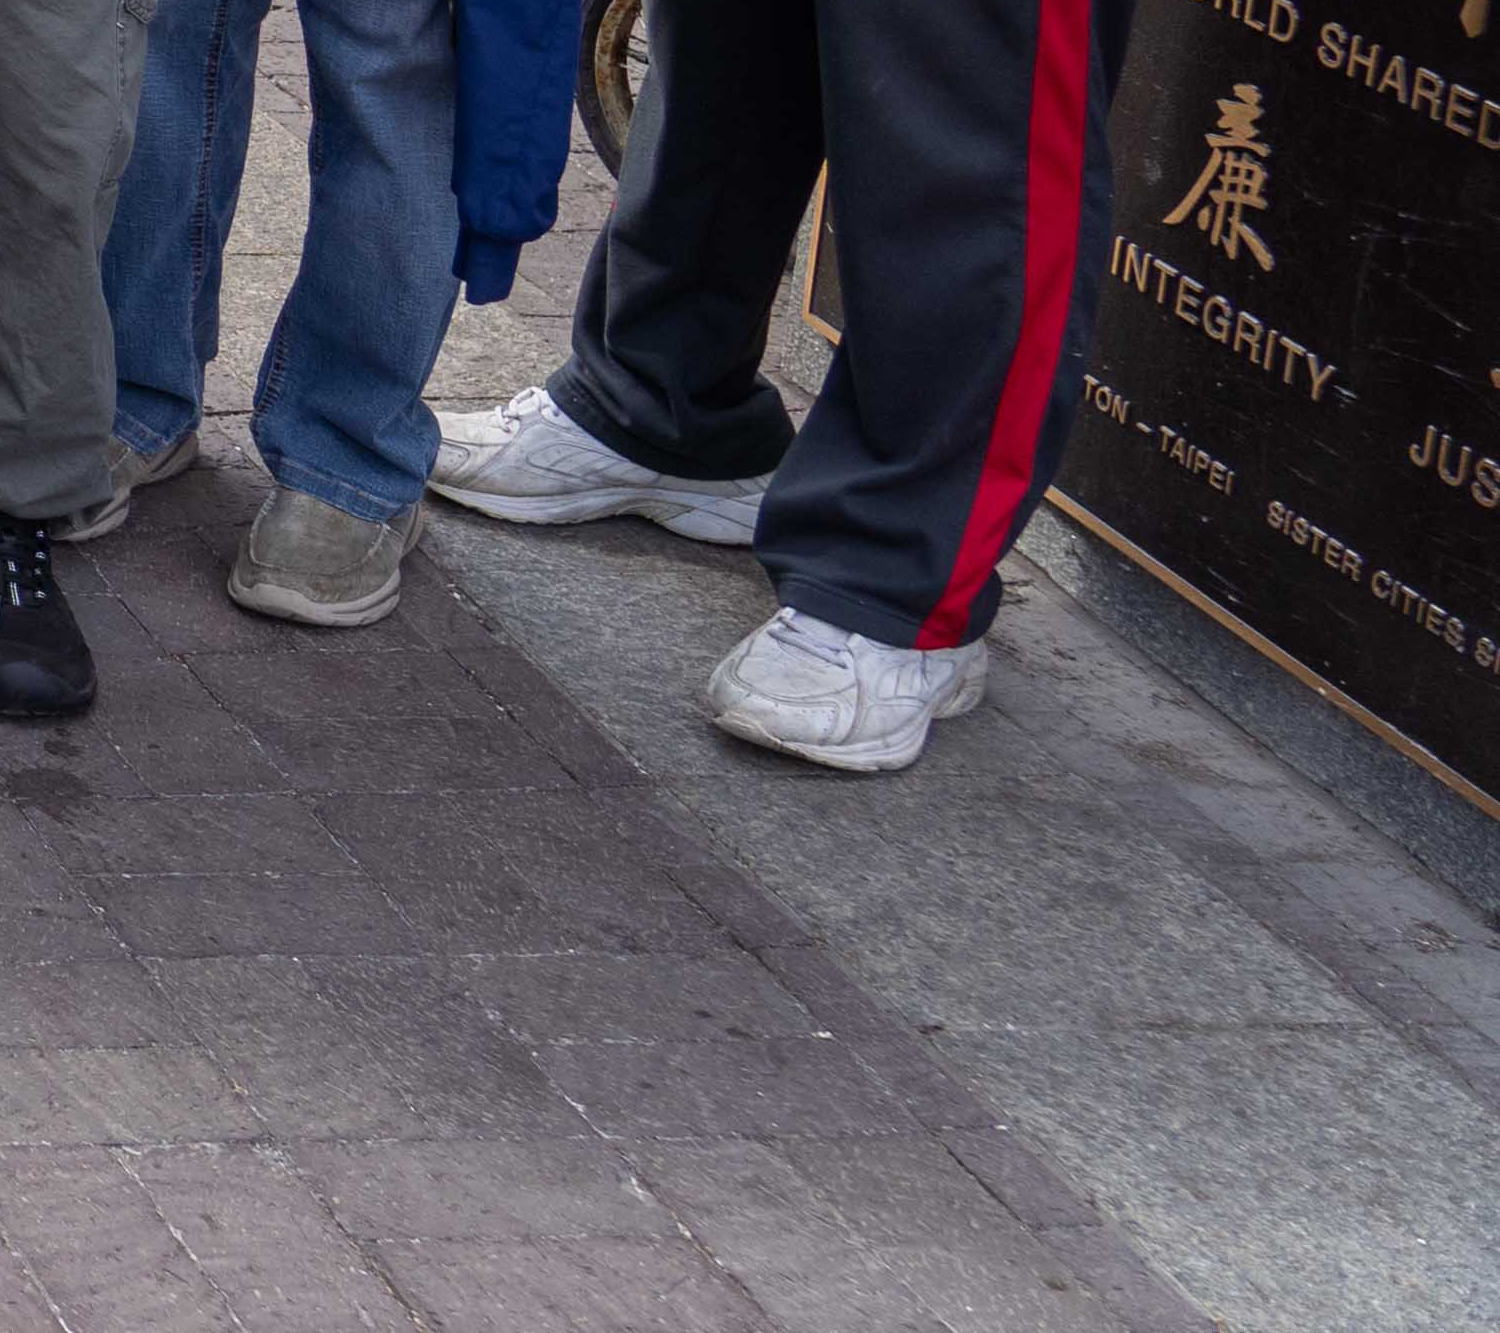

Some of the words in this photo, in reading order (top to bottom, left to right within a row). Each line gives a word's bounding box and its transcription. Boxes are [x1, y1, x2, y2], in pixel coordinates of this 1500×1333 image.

[1162, 83, 1275, 271] 廉
[1110, 235, 1338, 403] INTEGRITY
[1083, 373, 1131, 426] TON
[1159, 424, 1236, 496] TAIPEI
[1267, 500, 1363, 583] SISTER
